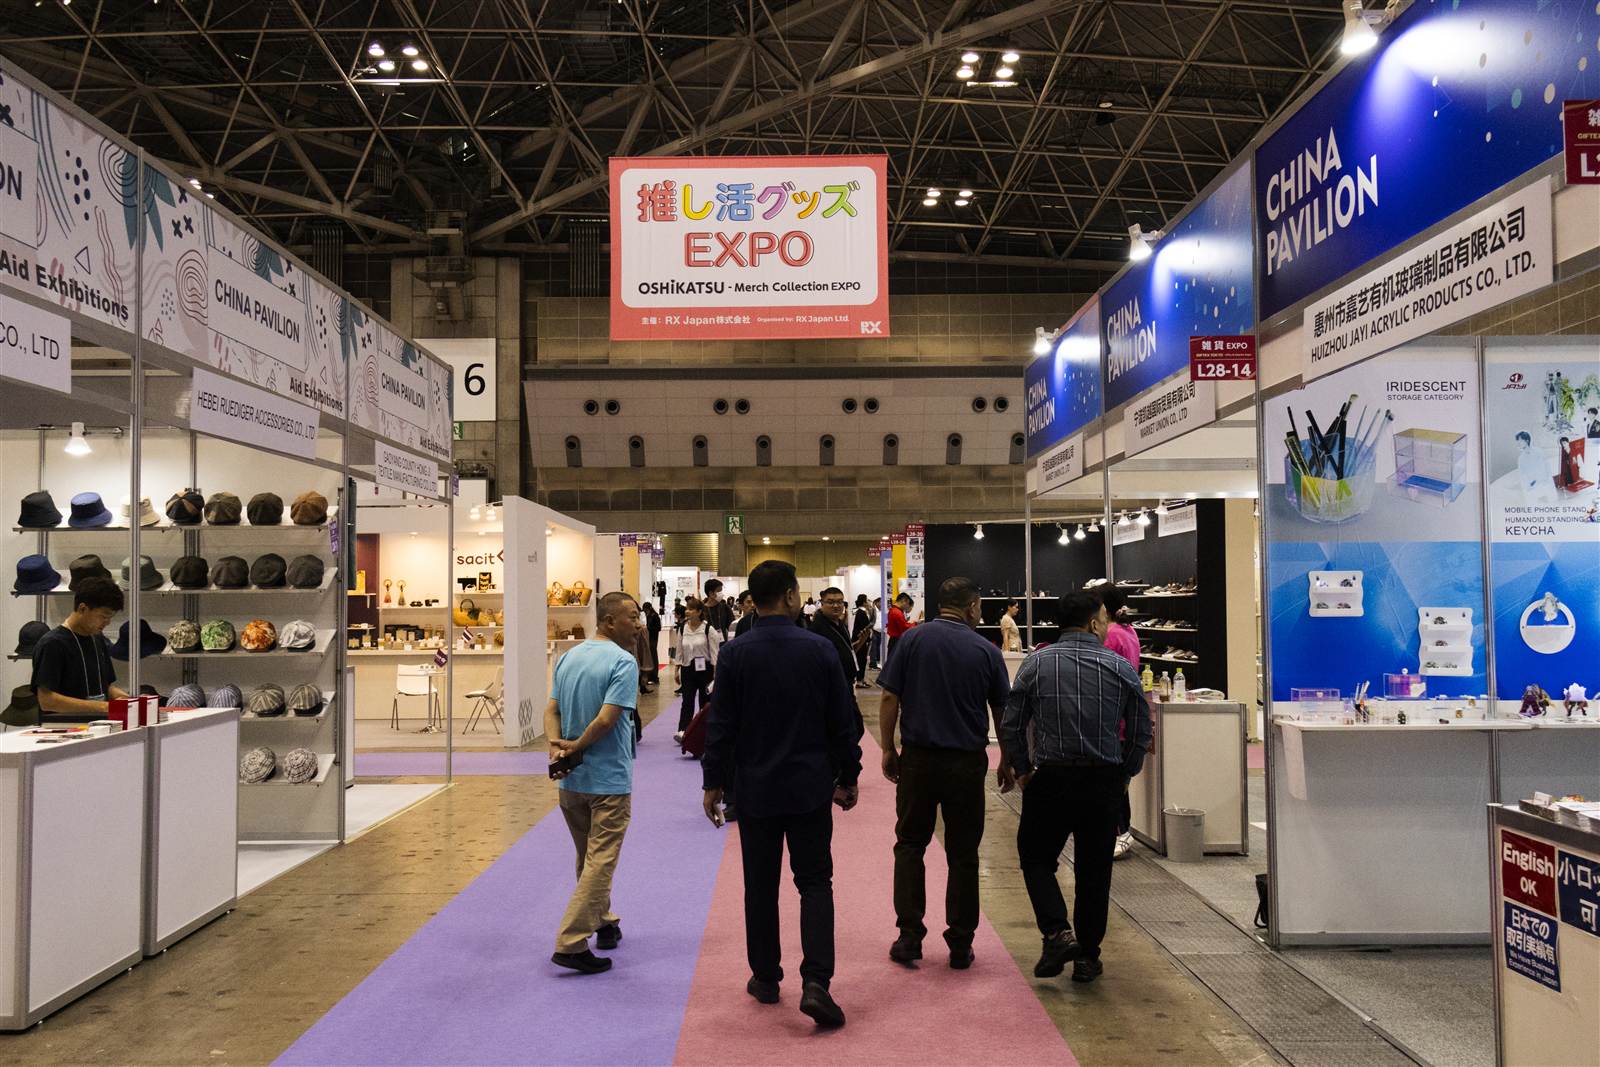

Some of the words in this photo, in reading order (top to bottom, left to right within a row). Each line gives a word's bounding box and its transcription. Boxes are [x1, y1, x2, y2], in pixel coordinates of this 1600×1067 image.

[1266, 126, 1342, 221] CHINA
[1580, 153, 1600, 177] L
[637, 180, 861, 222] 推し活グッズ
[1267, 154, 1379, 275] PAVILION
[684, 230, 815, 267] EXPO
[0, 250, 30, 281] Aid
[36, 264, 129, 320] Exhibitions
[734, 282, 769, 292] Merch
[772, 281, 829, 291] Collection
[831, 281, 861, 291] EXPO
[1313, 206, 1525, 338] 惠州市嘉艺有机玻璃制品有限公司
[214, 279, 252, 318] CHINA
[254, 300, 300, 343] PAVILION
[665, 316, 680, 325] RX
[808, 315, 834, 323] Japan
[1107, 295, 1142, 347] CHINA
[1311, 333, 1348, 363] HUIZHOU
[1350, 325, 1368, 347] JAYI
[1370, 305, 1409, 337] ACRYLIC
[1412, 276, 1472, 320] PRODUCTS
[1477, 267, 1501, 291] CO.,
[1505, 251, 1536, 279] LTD.
[861, 321, 881, 333] RX
[32, 333, 60, 360] LTD
[1108, 321, 1157, 383] PAVILION
[1226, 342, 1248, 350] EXPO
[464, 363, 486, 396] 6
[1197, 363, 1251, 377] L28-14
[1386, 381, 1466, 392] IRIDESCENT
[289, 377, 302, 395] Aid
[304, 383, 343, 413] Exhibitions
[381, 372, 400, 397] CHINA
[401, 383, 425, 410] PAVILION
[1028, 376, 1047, 410] CHINA
[198, 390, 220, 412] HEBEI
[254, 407, 294, 435] ACCESSORIES
[305, 424, 316, 440] LTD
[1028, 397, 1055, 437] PAVILION
[1505, 526, 1555, 535] KEYCHA
[457, 552, 495, 565] sacit
[1503, 841, 1554, 878] English
[1520, 876, 1538, 897] OK
[1511, 908, 1550, 940] 日本での
[1579, 899, 1599, 931] 可
[1506, 926, 1555, 965] 取引実績有
